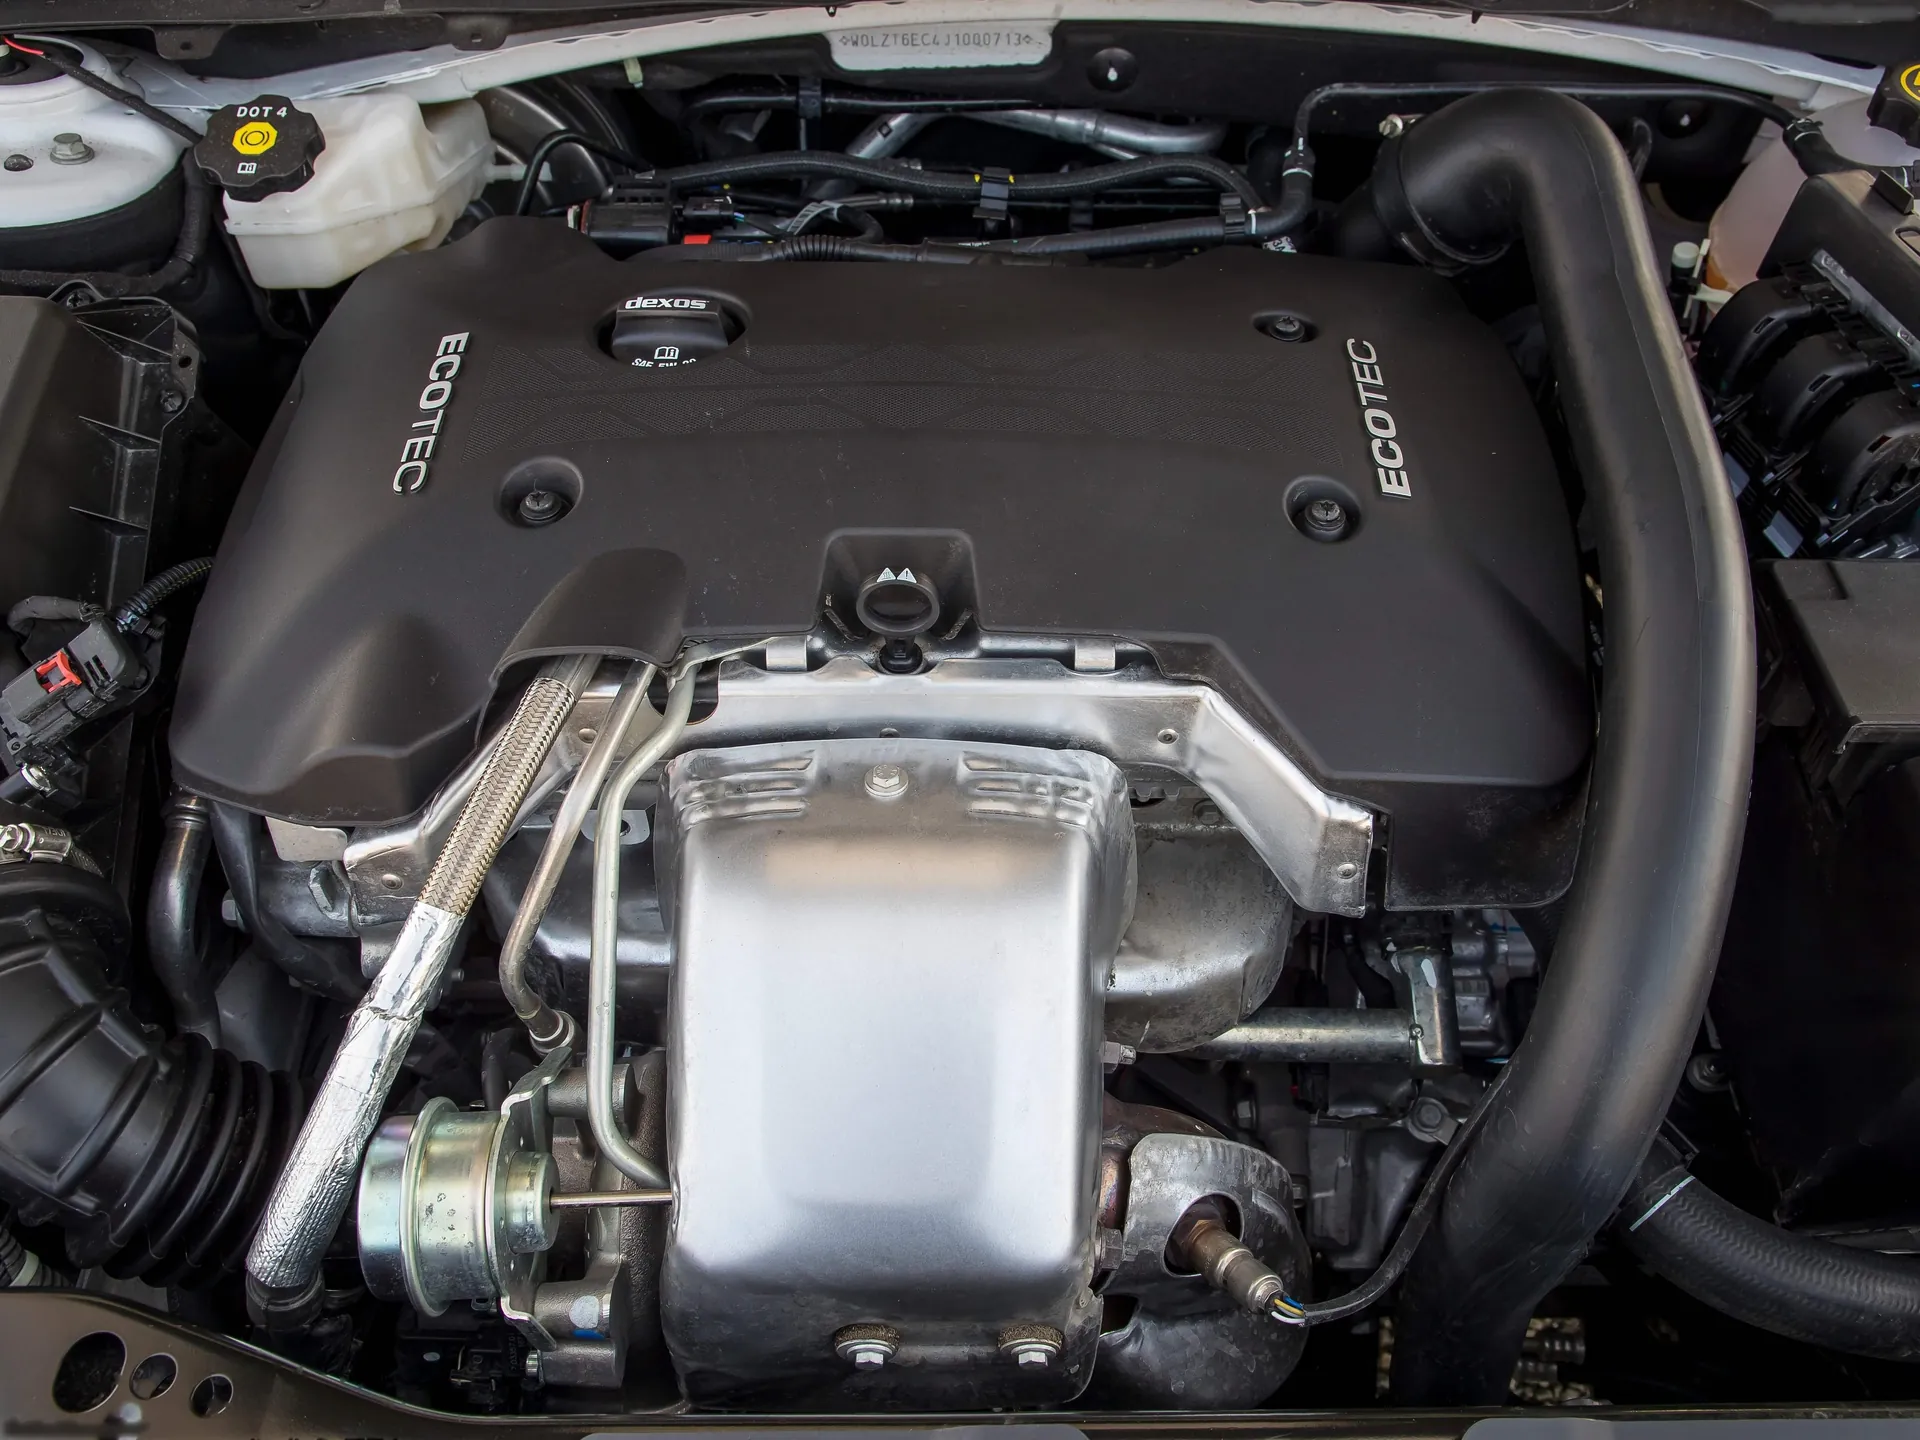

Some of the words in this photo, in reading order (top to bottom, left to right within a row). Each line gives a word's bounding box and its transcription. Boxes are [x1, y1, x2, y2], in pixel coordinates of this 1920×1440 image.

[236, 106, 273, 118] DOT
[276, 106, 288, 118] 4
[625, 296, 707, 310] dexos
[393, 331, 470, 493] ECOTEC
[1346, 337, 1412, 498] ECOTEC
